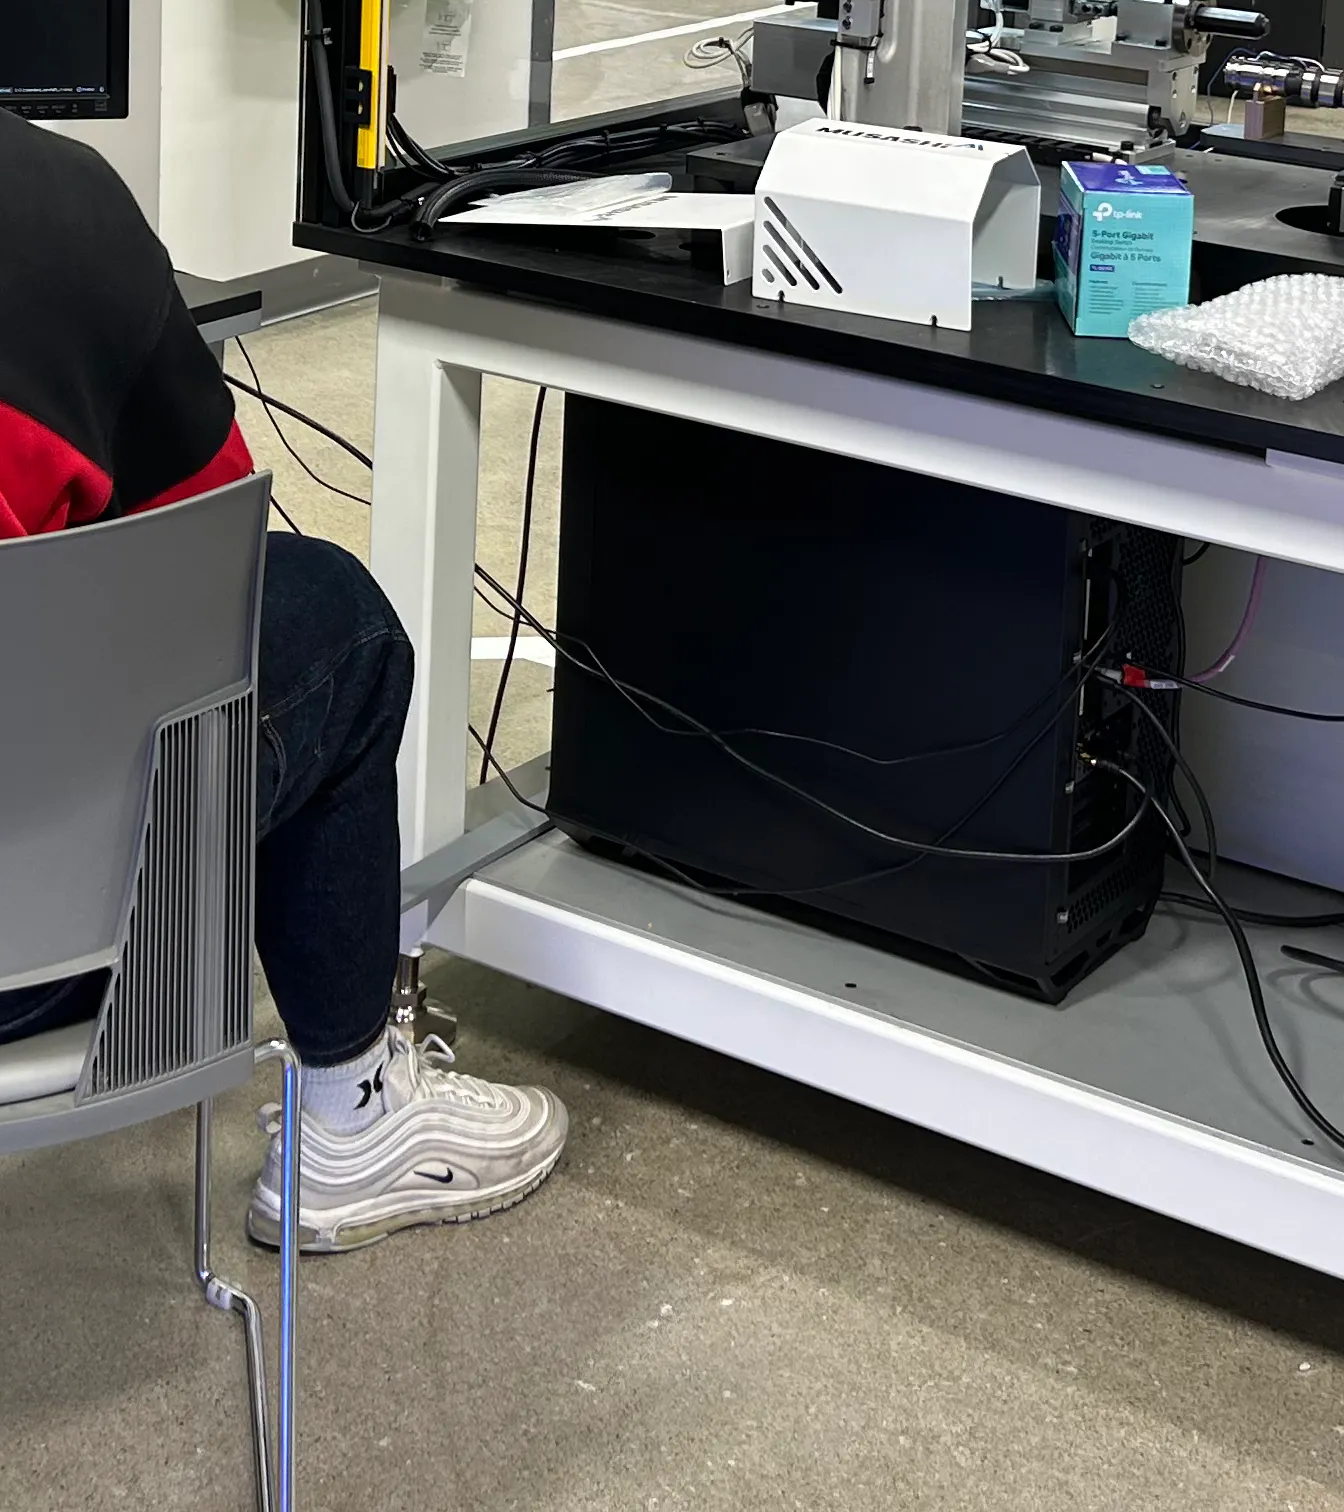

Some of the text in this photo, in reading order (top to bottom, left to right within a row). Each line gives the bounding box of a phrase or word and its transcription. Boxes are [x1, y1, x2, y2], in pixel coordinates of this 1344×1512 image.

[1112, 210, 1143, 220] tp-link
[1091, 229, 1154, 240] 5-Port Gigabit
[1090, 251, 1122, 262] Gigabit
[1130, 252, 1136, 261] 5
[1137, 252, 1162, 263] Ports
